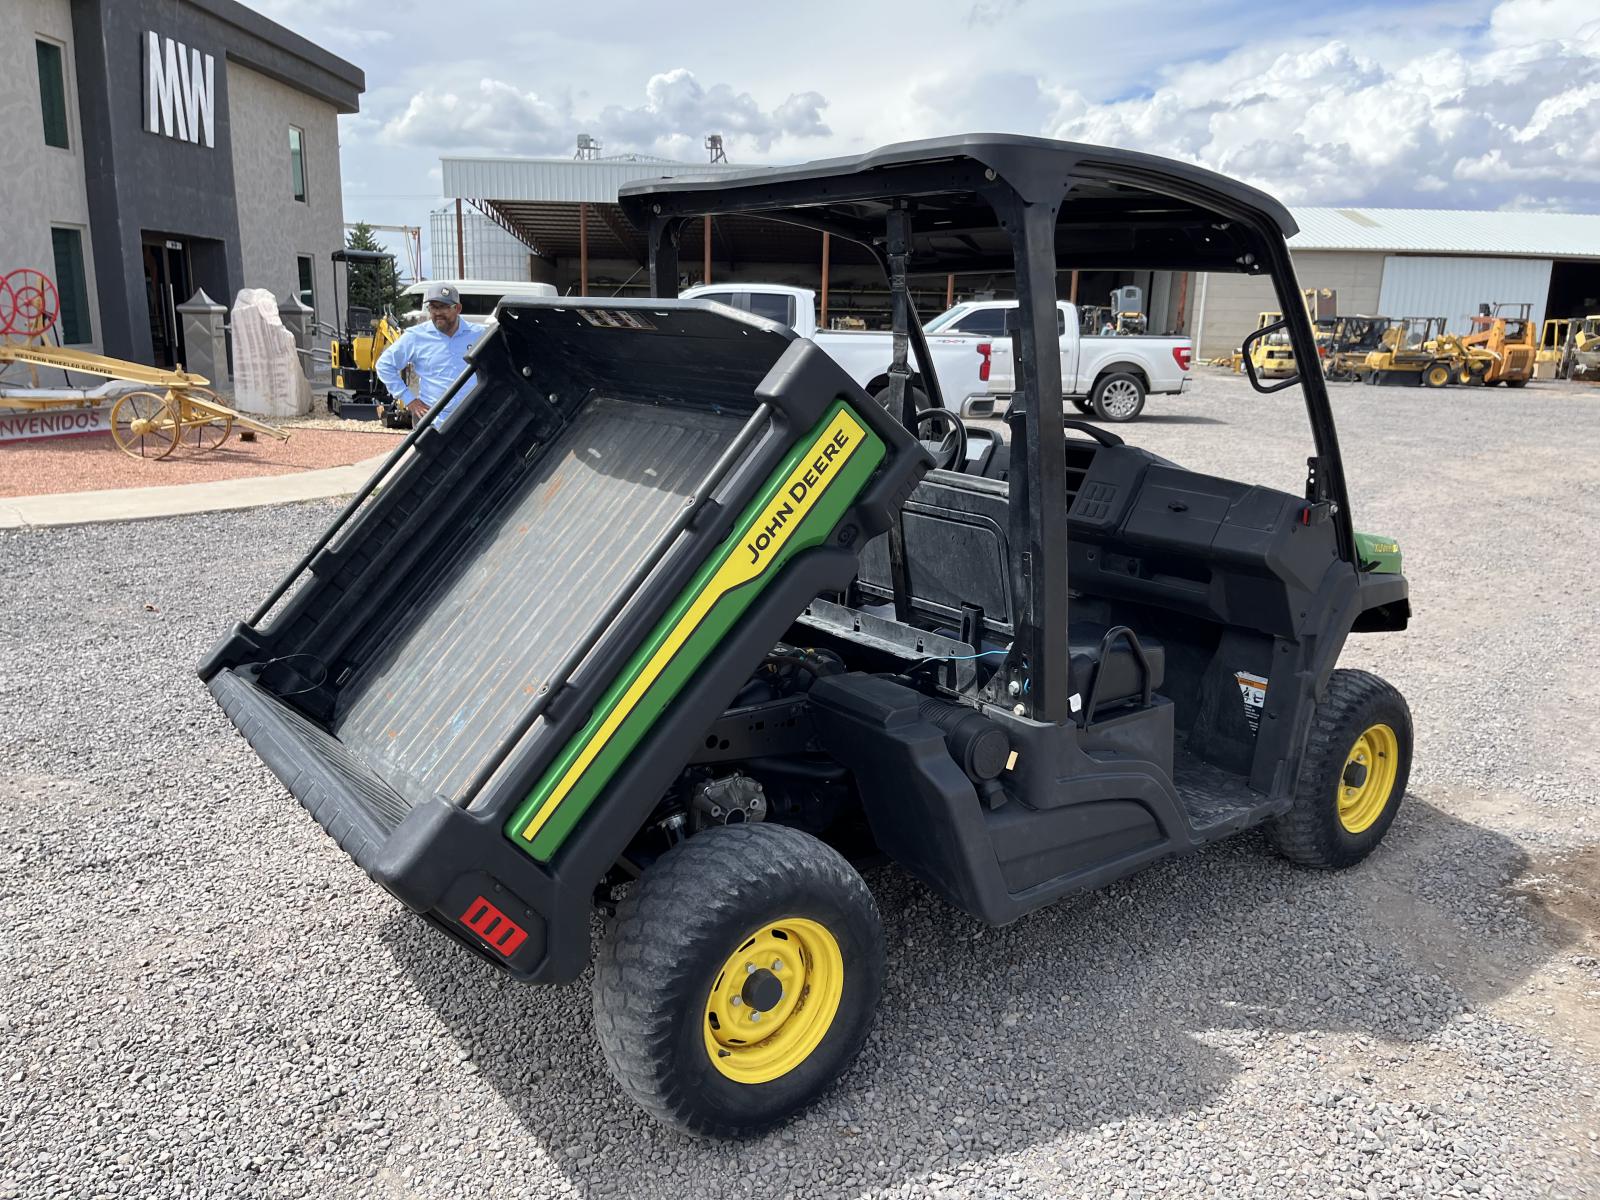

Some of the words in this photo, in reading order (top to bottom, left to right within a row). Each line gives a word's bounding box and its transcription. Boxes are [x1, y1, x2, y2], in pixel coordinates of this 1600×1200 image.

[148, 30, 215, 148] MW
[14, 352, 47, 363] WESTERN
[48, 359, 80, 369] WHEELED
[81, 364, 113, 375] SCRAPER
[747, 501, 795, 565] JOHN
[788, 429, 850, 504] DEERE
